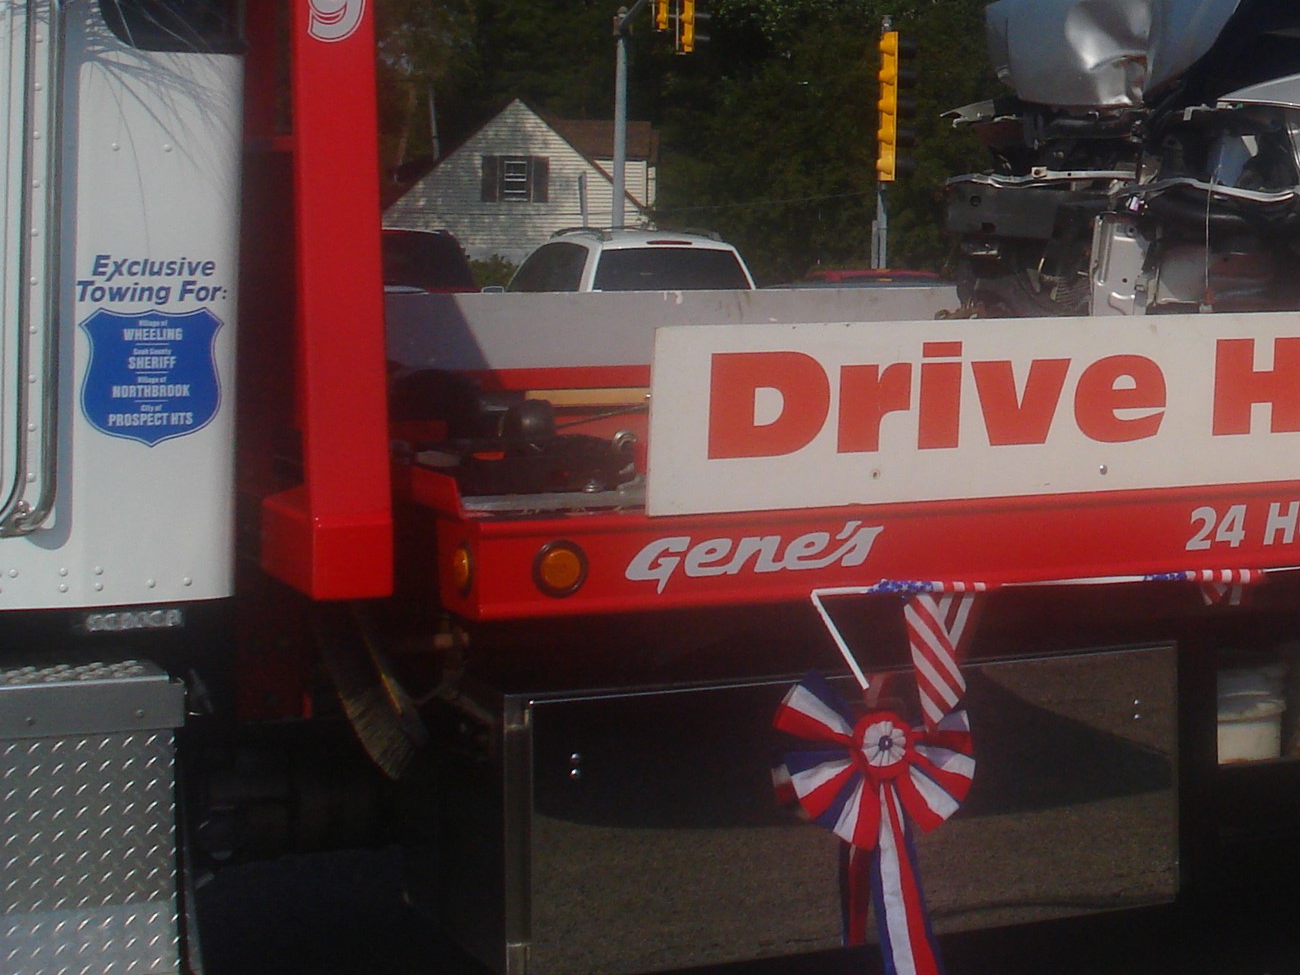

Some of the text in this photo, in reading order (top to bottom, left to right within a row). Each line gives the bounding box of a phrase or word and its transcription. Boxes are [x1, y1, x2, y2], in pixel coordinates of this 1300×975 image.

[92, 254, 216, 282] Exclusive
[76, 280, 228, 305] Towing For:
[123, 328, 183, 341] WHEELING
[128, 356, 177, 369] SHERIFF
[112, 384, 190, 398] NORTHBROOK
[707, 341, 1168, 460] Drive
[108, 412, 193, 426] PROSPECT HTS
[1185, 504, 1247, 551] 24
[625, 520, 884, 594] Gene's
